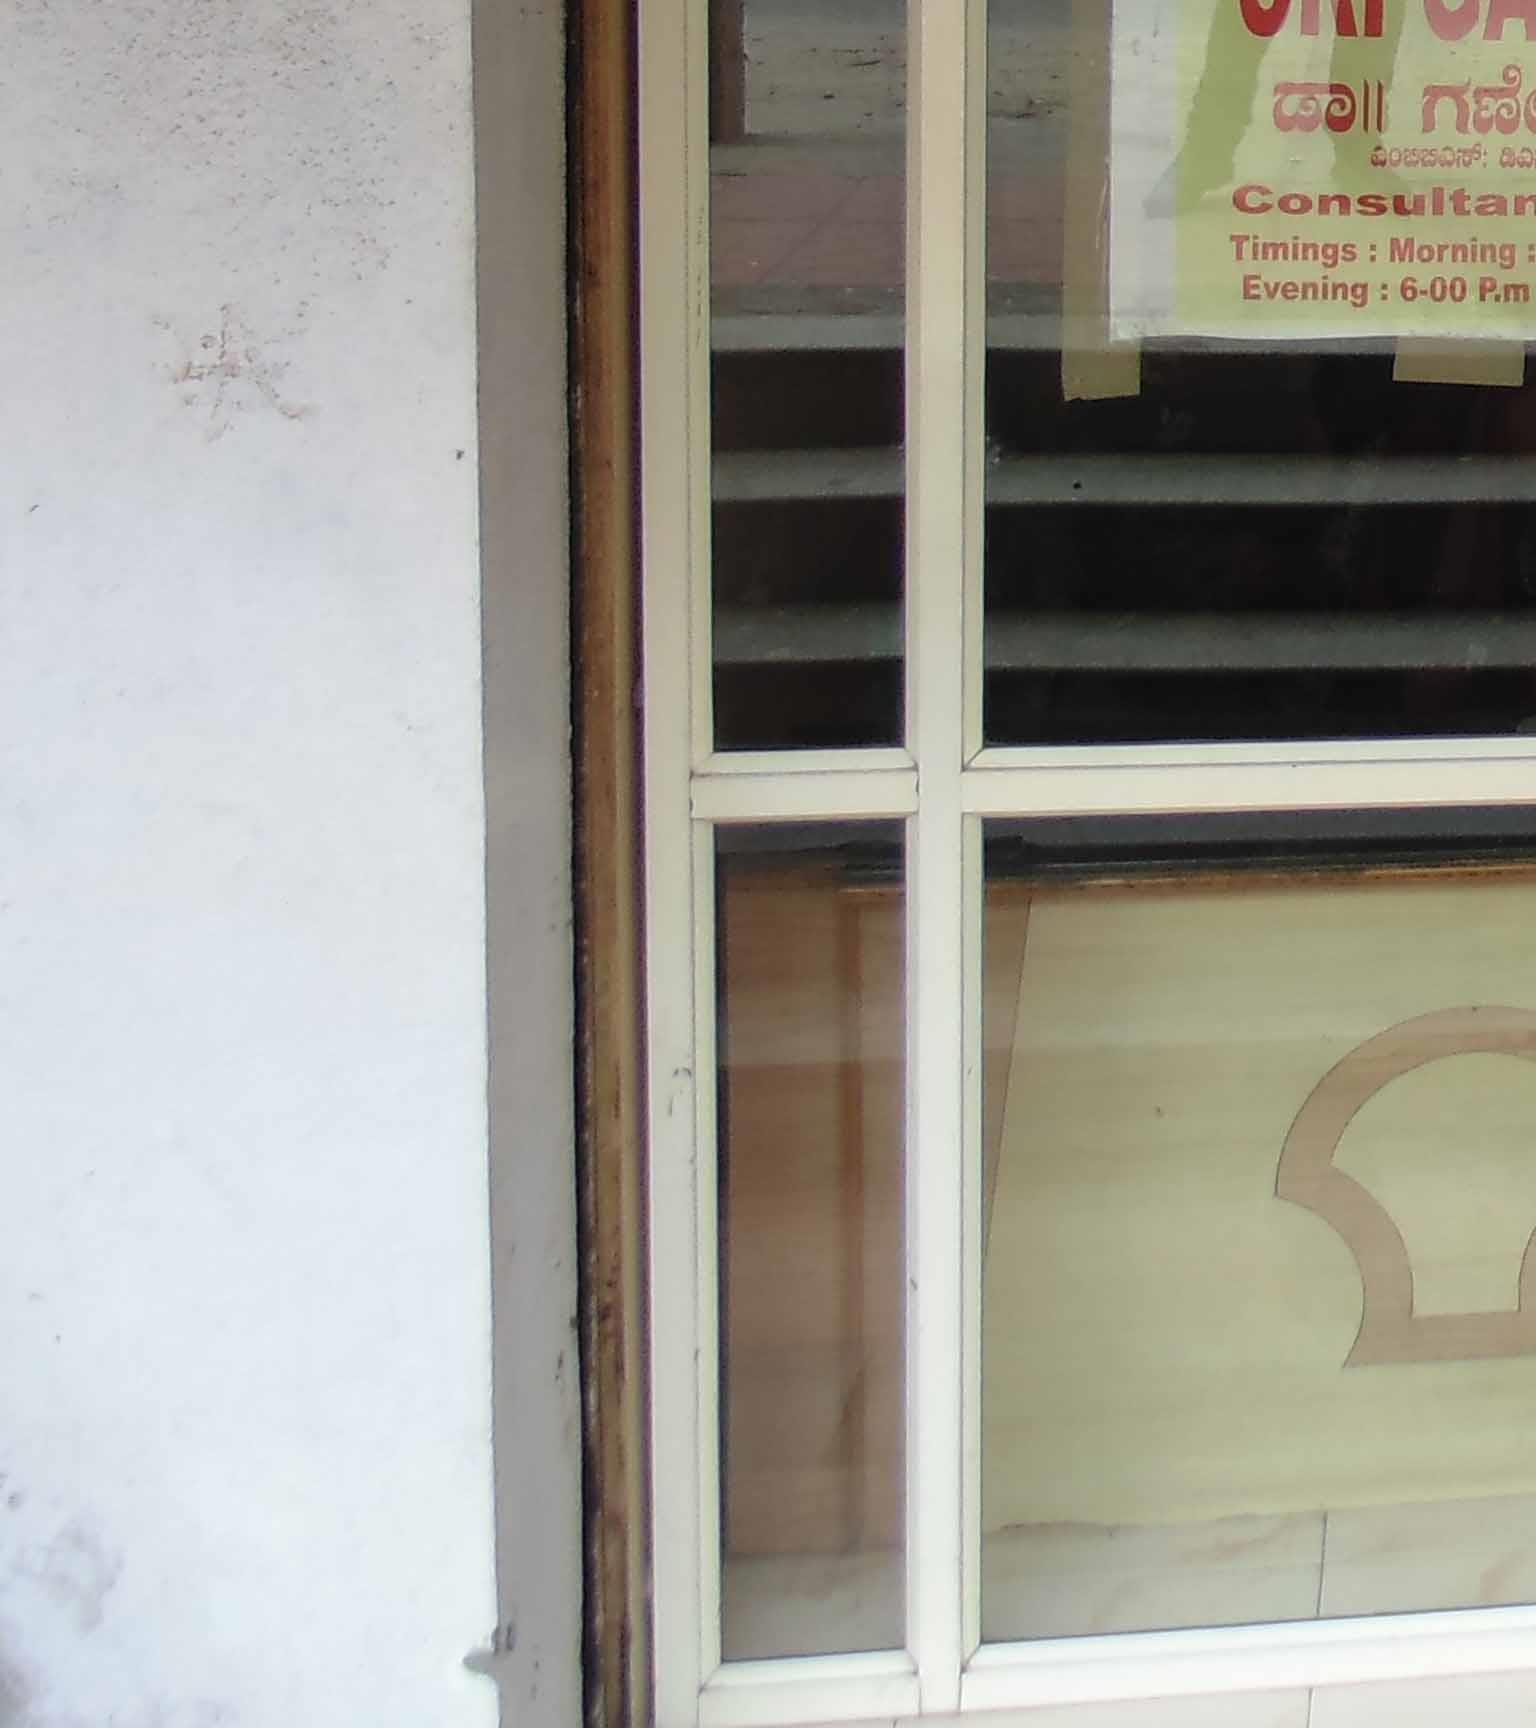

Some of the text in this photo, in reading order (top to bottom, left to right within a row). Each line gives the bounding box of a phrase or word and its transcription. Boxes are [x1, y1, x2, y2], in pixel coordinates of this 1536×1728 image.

[1230, 235, 1358, 270] Timings
[1389, 238, 1516, 269] Morning
[1242, 275, 1370, 308] Evening
[1400, 276, 1468, 304] 6-00
[1479, 276, 1530, 303] P.m
